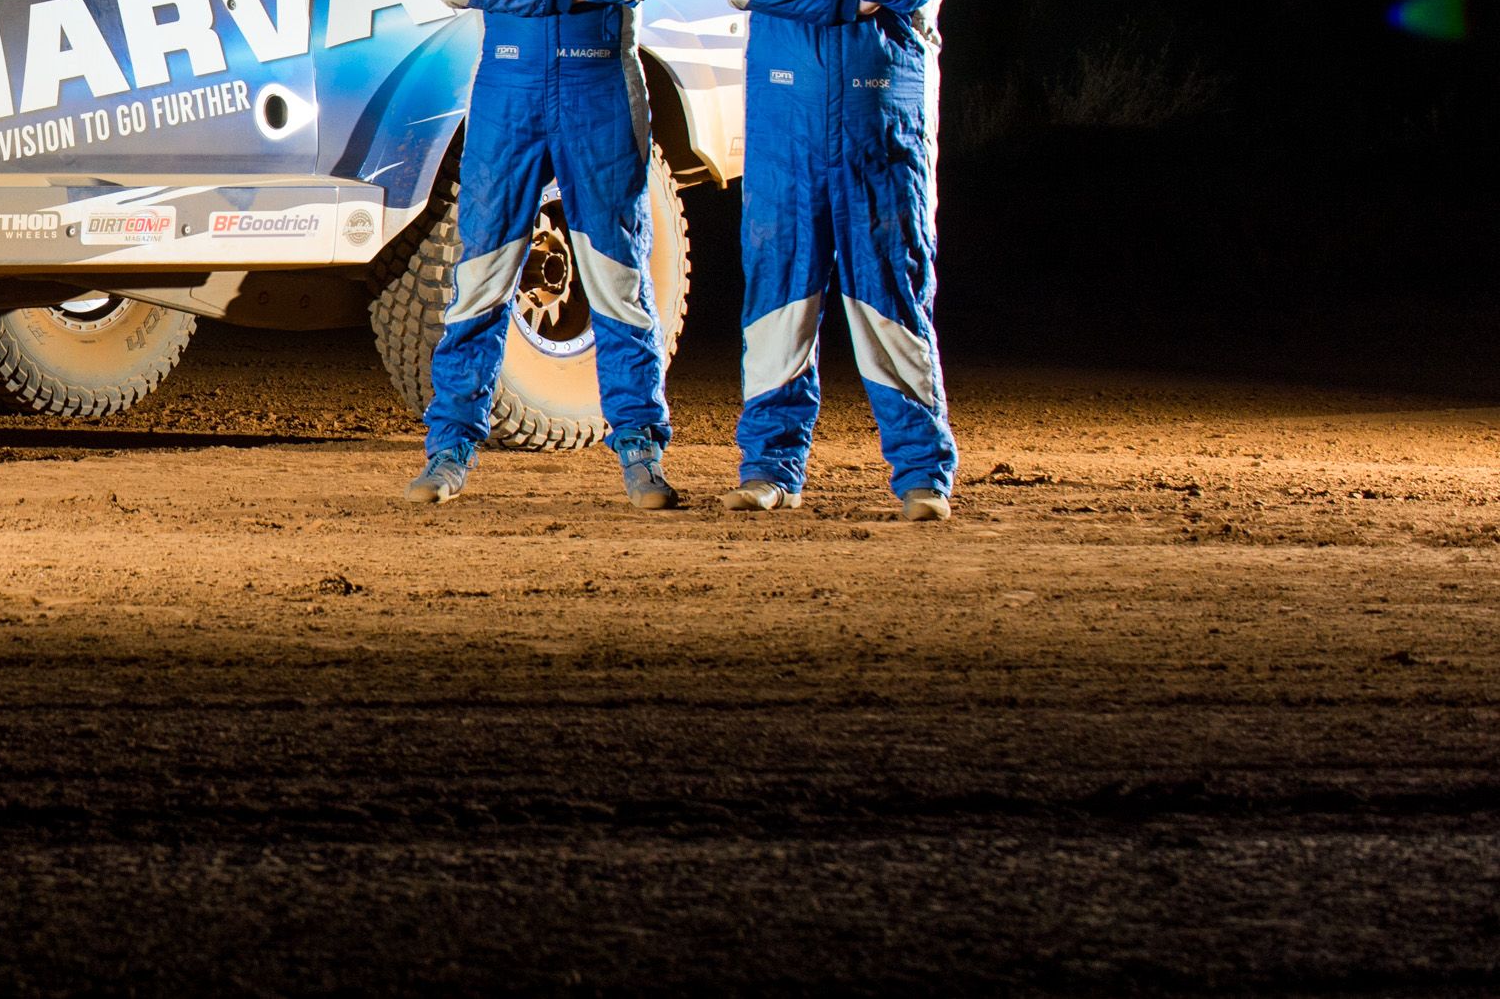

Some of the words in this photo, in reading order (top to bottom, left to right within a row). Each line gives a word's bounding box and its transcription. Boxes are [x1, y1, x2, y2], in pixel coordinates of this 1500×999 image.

[496, 46, 517, 55] rpm
[570, 48, 611, 58] MAGHER
[771, 71, 792, 80] rpm
[864, 78, 891, 88] HOSE
[80, 109, 110, 144] TO
[116, 101, 147, 136] GO
[151, 79, 251, 129] FURTHER
[213, 214, 320, 232] BFGoodrich
[5, 230, 58, 240] WHEELS
[124, 235, 163, 243] MAGAZINE
